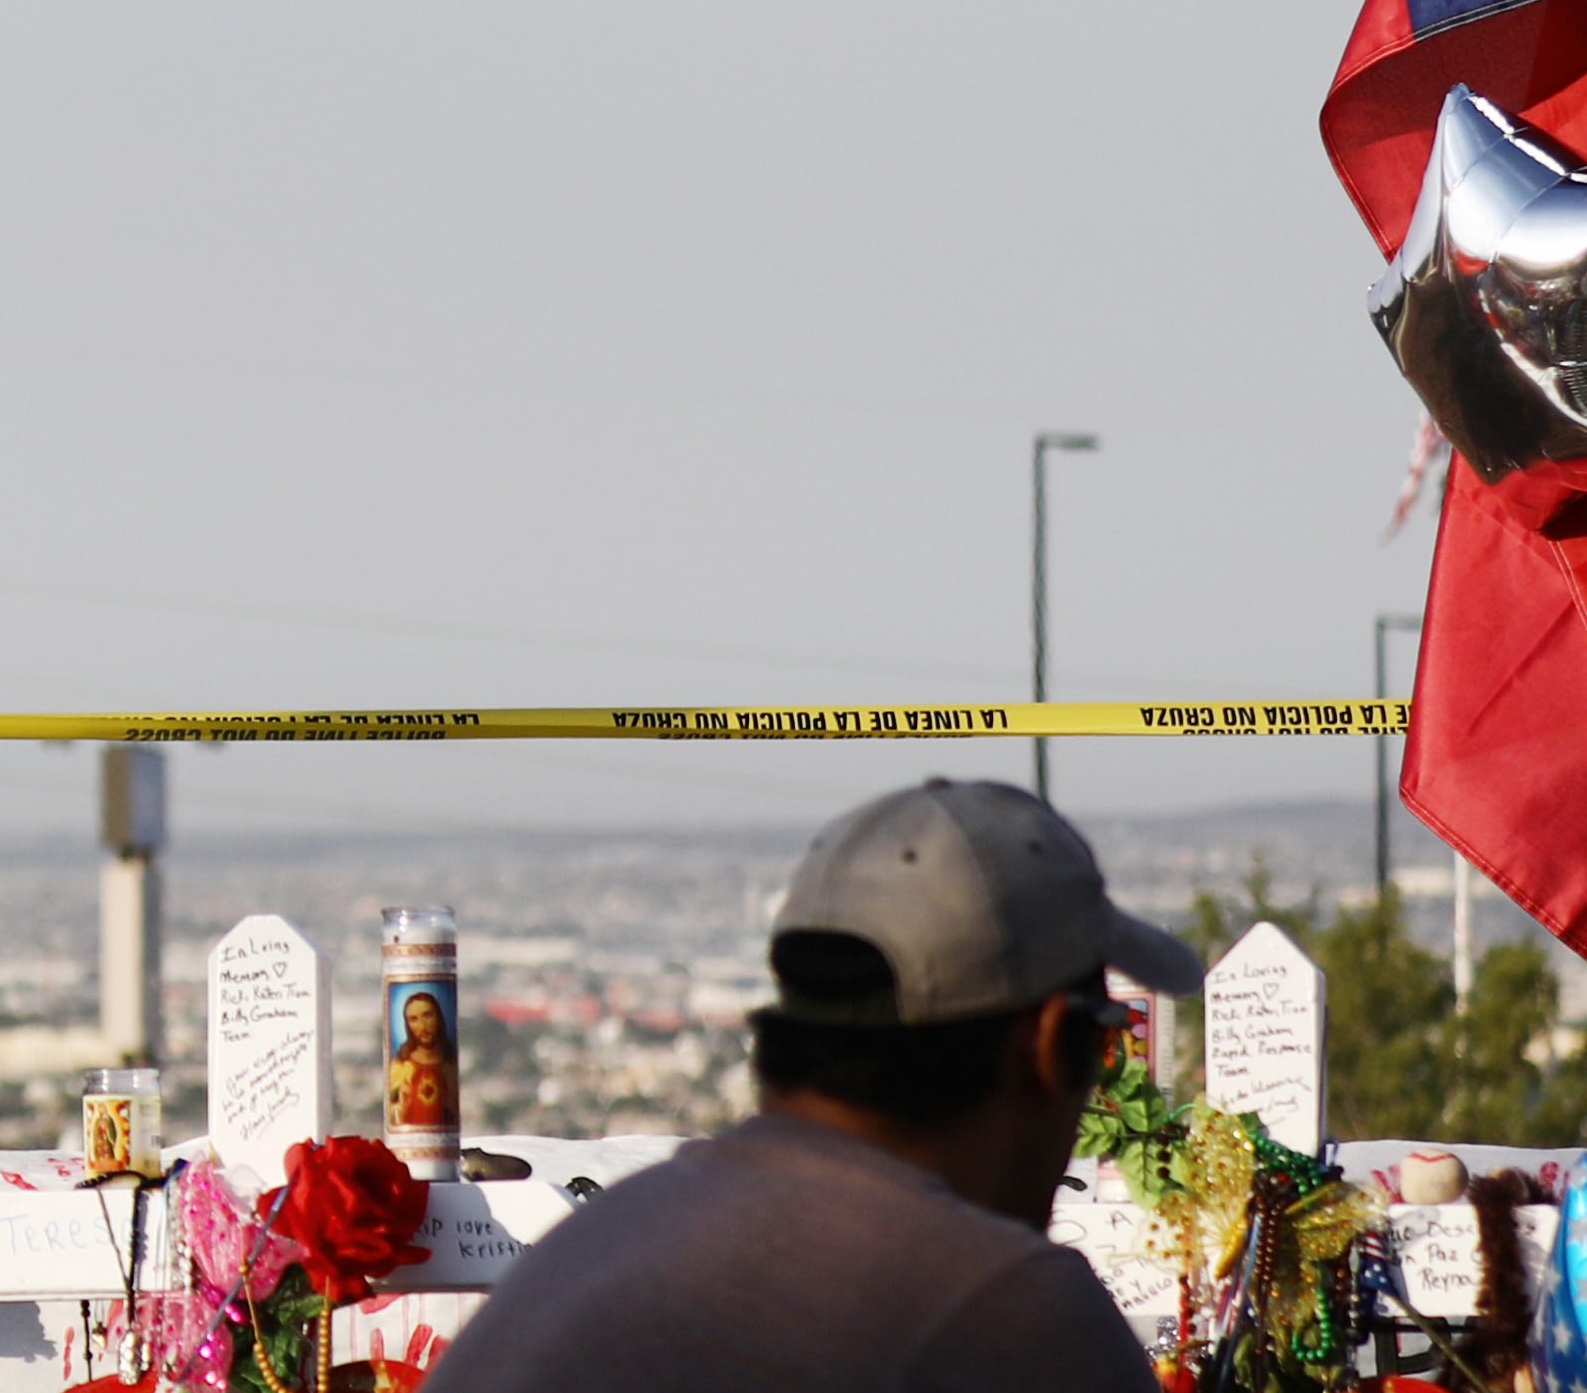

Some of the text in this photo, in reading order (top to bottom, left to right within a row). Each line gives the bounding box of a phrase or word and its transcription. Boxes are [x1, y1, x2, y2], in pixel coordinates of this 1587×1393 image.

[736, 711, 826, 730] POLICIA
[833, 711, 862, 731] LA
[869, 710, 898, 731] DE
[904, 709, 974, 731] LINEA
[978, 709, 1008, 730] LA
[1140, 707, 1215, 727] CRUZA
[1222, 706, 1257, 725] NO
[1263, 705, 1352, 725] POLICIA
[1359, 705, 1387, 724] LA
